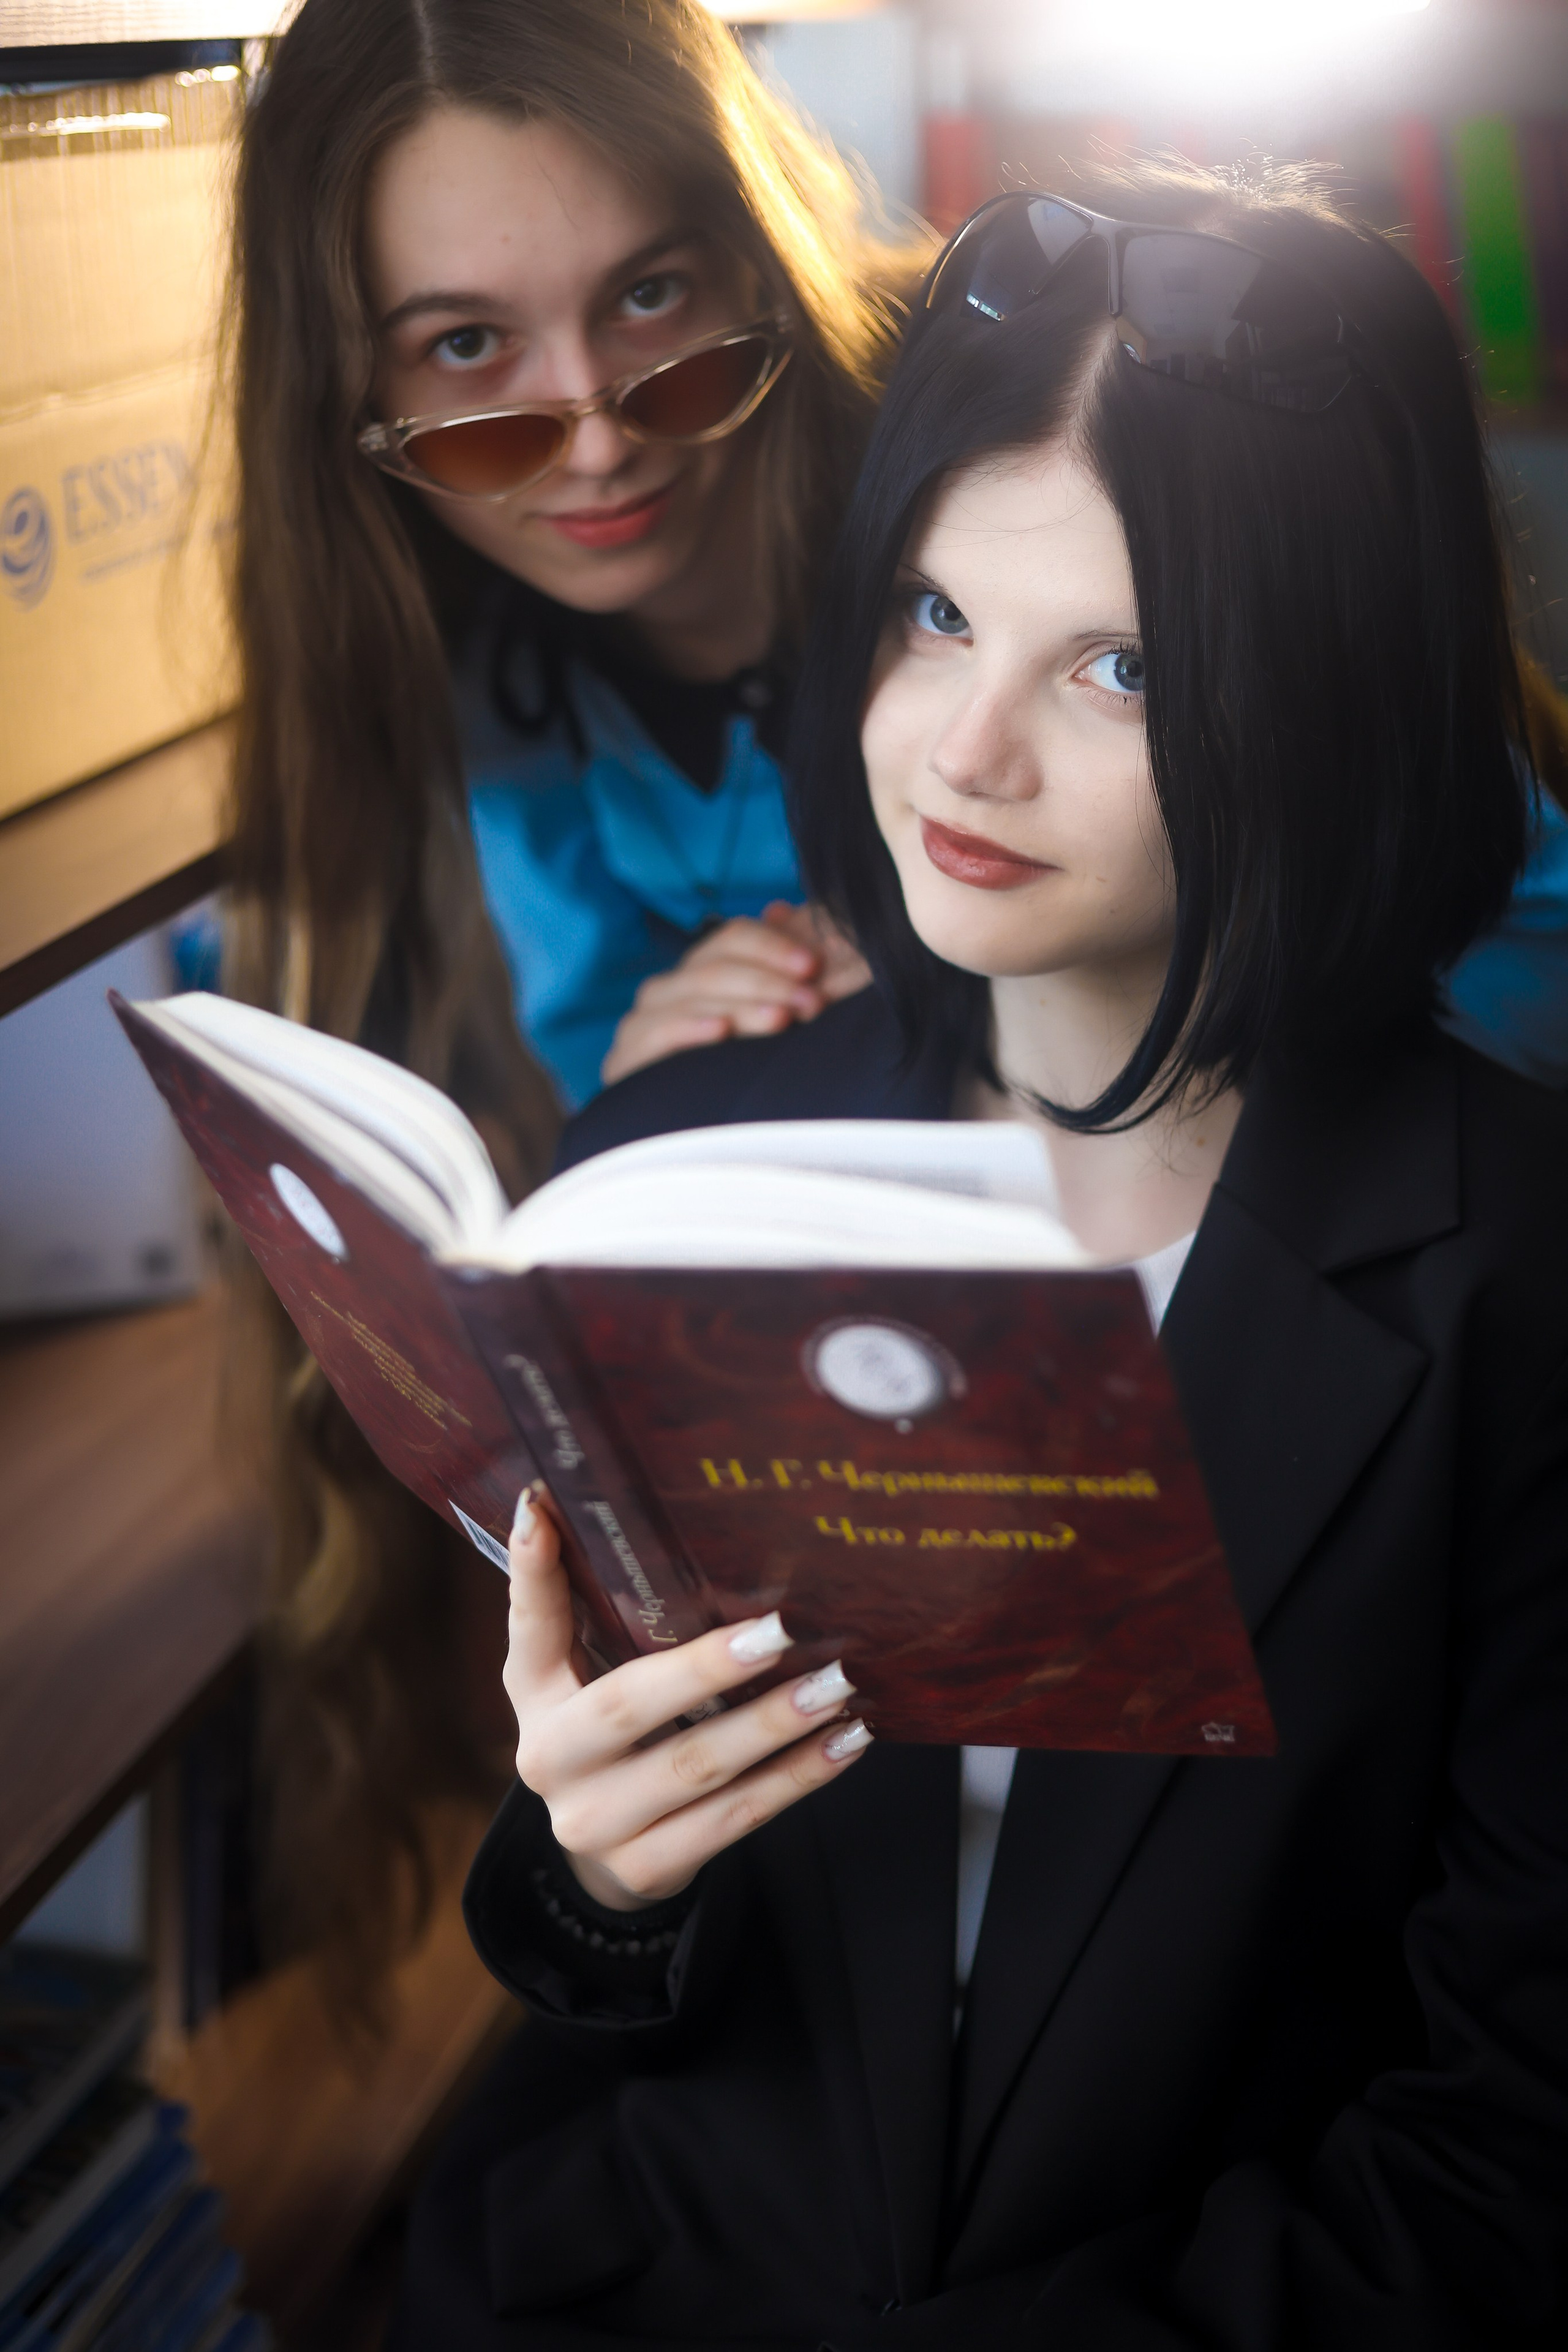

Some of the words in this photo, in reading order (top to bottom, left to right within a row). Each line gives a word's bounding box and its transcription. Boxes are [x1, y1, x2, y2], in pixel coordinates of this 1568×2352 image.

[701, 1458, 764, 1488] Н.
[771, 1458, 813, 1490] Г.
[817, 1459, 1159, 1500] Чернышевский
[815, 1516, 905, 1545] Что
[918, 1521, 1077, 1551] делать?
